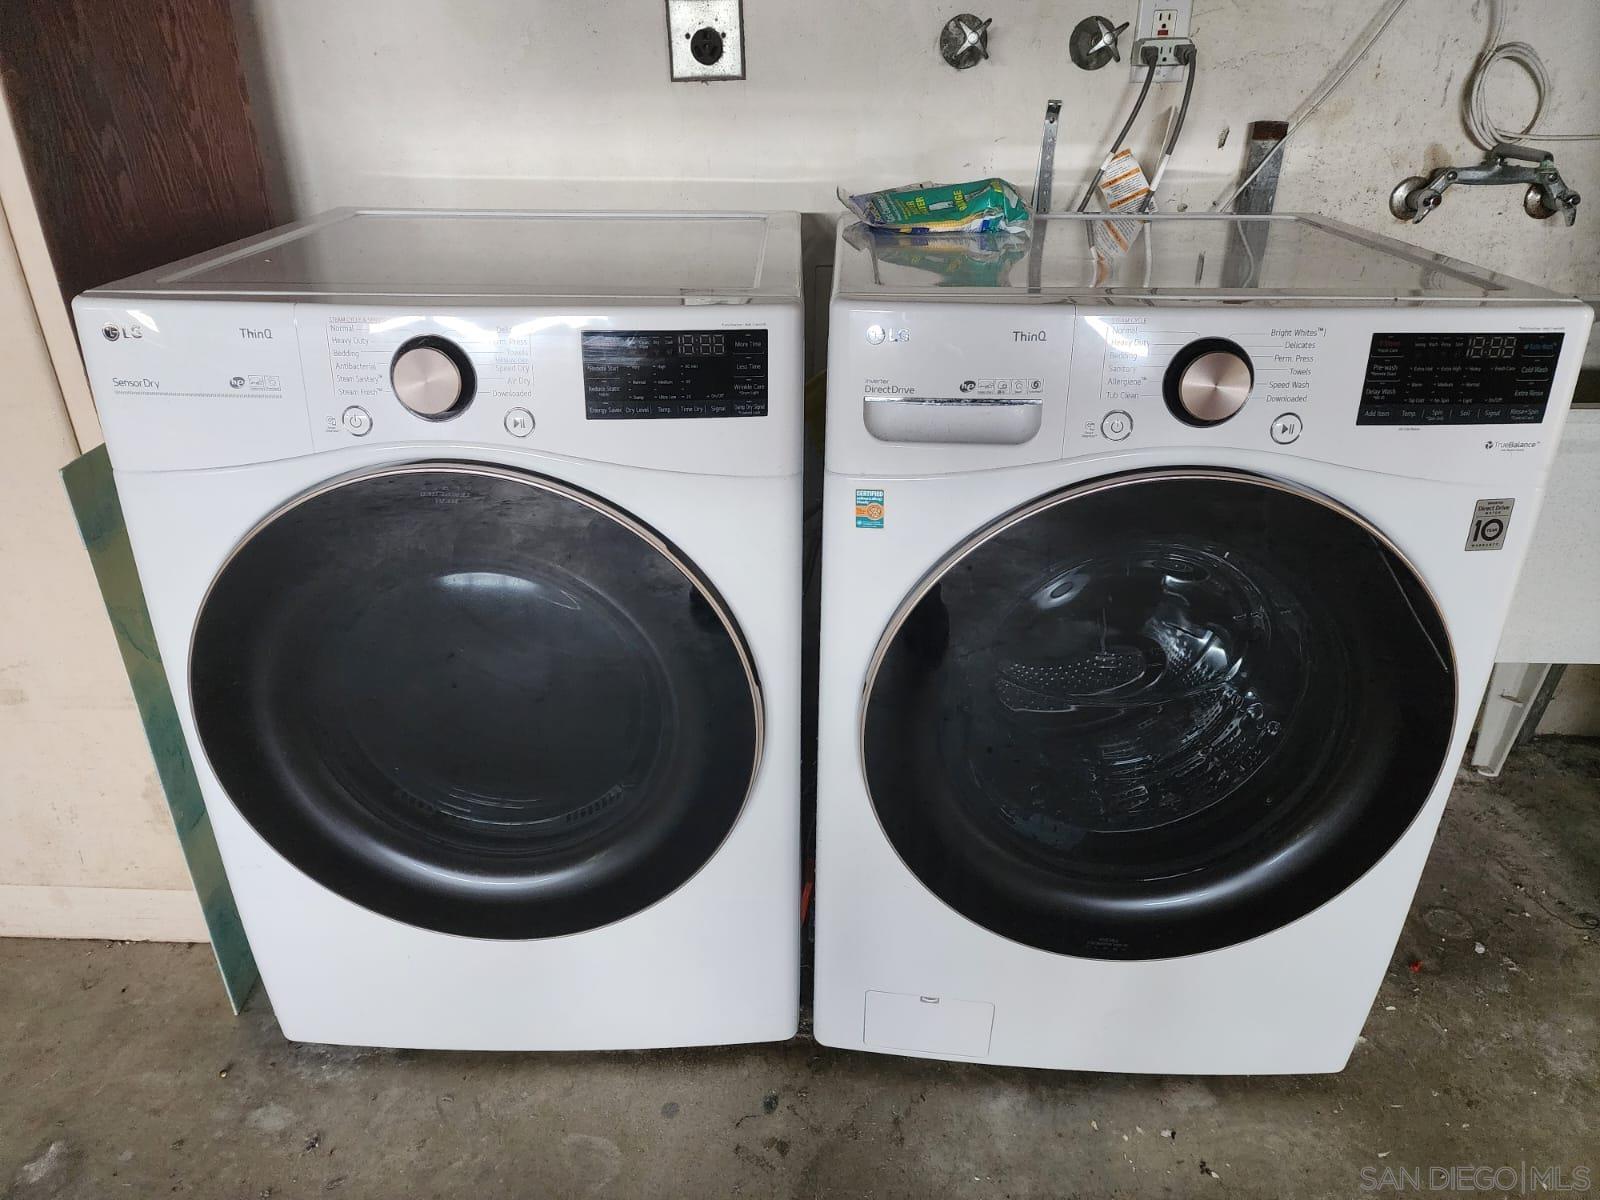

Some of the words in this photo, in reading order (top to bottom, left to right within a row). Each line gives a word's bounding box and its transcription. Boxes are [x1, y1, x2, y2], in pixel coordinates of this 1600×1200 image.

[330, 324, 354, 332] Normal
[1112, 325, 1137, 334] Normal
[239, 327, 273, 339] ThinQ
[1012, 330, 1047, 342] ThinQ
[1270, 328, 1292, 339] Bright
[332, 336, 352, 346] Heavy
[734, 340, 749, 349] More
[749, 339, 762, 348] Time
[1284, 341, 1316, 349] Delicates
[333, 349, 360, 359] Bedding
[1295, 354, 1314, 363] Press
[336, 362, 377, 371] Antibacterial
[495, 364, 513, 373] Speed
[514, 364, 530, 373] Dry
[736, 363, 748, 371] Less
[748, 363, 762, 371] Time
[1290, 367, 1312, 376] Towels
[336, 374, 355, 384] Steam
[507, 376, 518, 385] Air
[519, 376, 531, 386] Dry
[733, 383, 753, 391] Wrinkle
[753, 383, 766, 391] Care
[1269, 381, 1290, 390] Speed
[1292, 380, 1310, 389] Wash
[338, 388, 358, 397] Steam
[492, 389, 532, 398] Downloaded
[1106, 391, 1120, 400] Tub
[1121, 391, 1140, 400] Clean
[1365, 388, 1381, 396] Delay
[1266, 394, 1308, 403] Downloaded
[588, 406, 607, 415] Energy
[607, 406, 622, 414] Saver
[625, 406, 636, 415] Dry
[635, 406, 650, 414] Level
[680, 405, 694, 413] Time
[710, 405, 727, 414] Signal
[1432, 408, 1444, 416] Spin
[1460, 409, 1470, 417] Soil
[1485, 408, 1501, 418] Signal
[1472, 518, 1504, 542] 10
